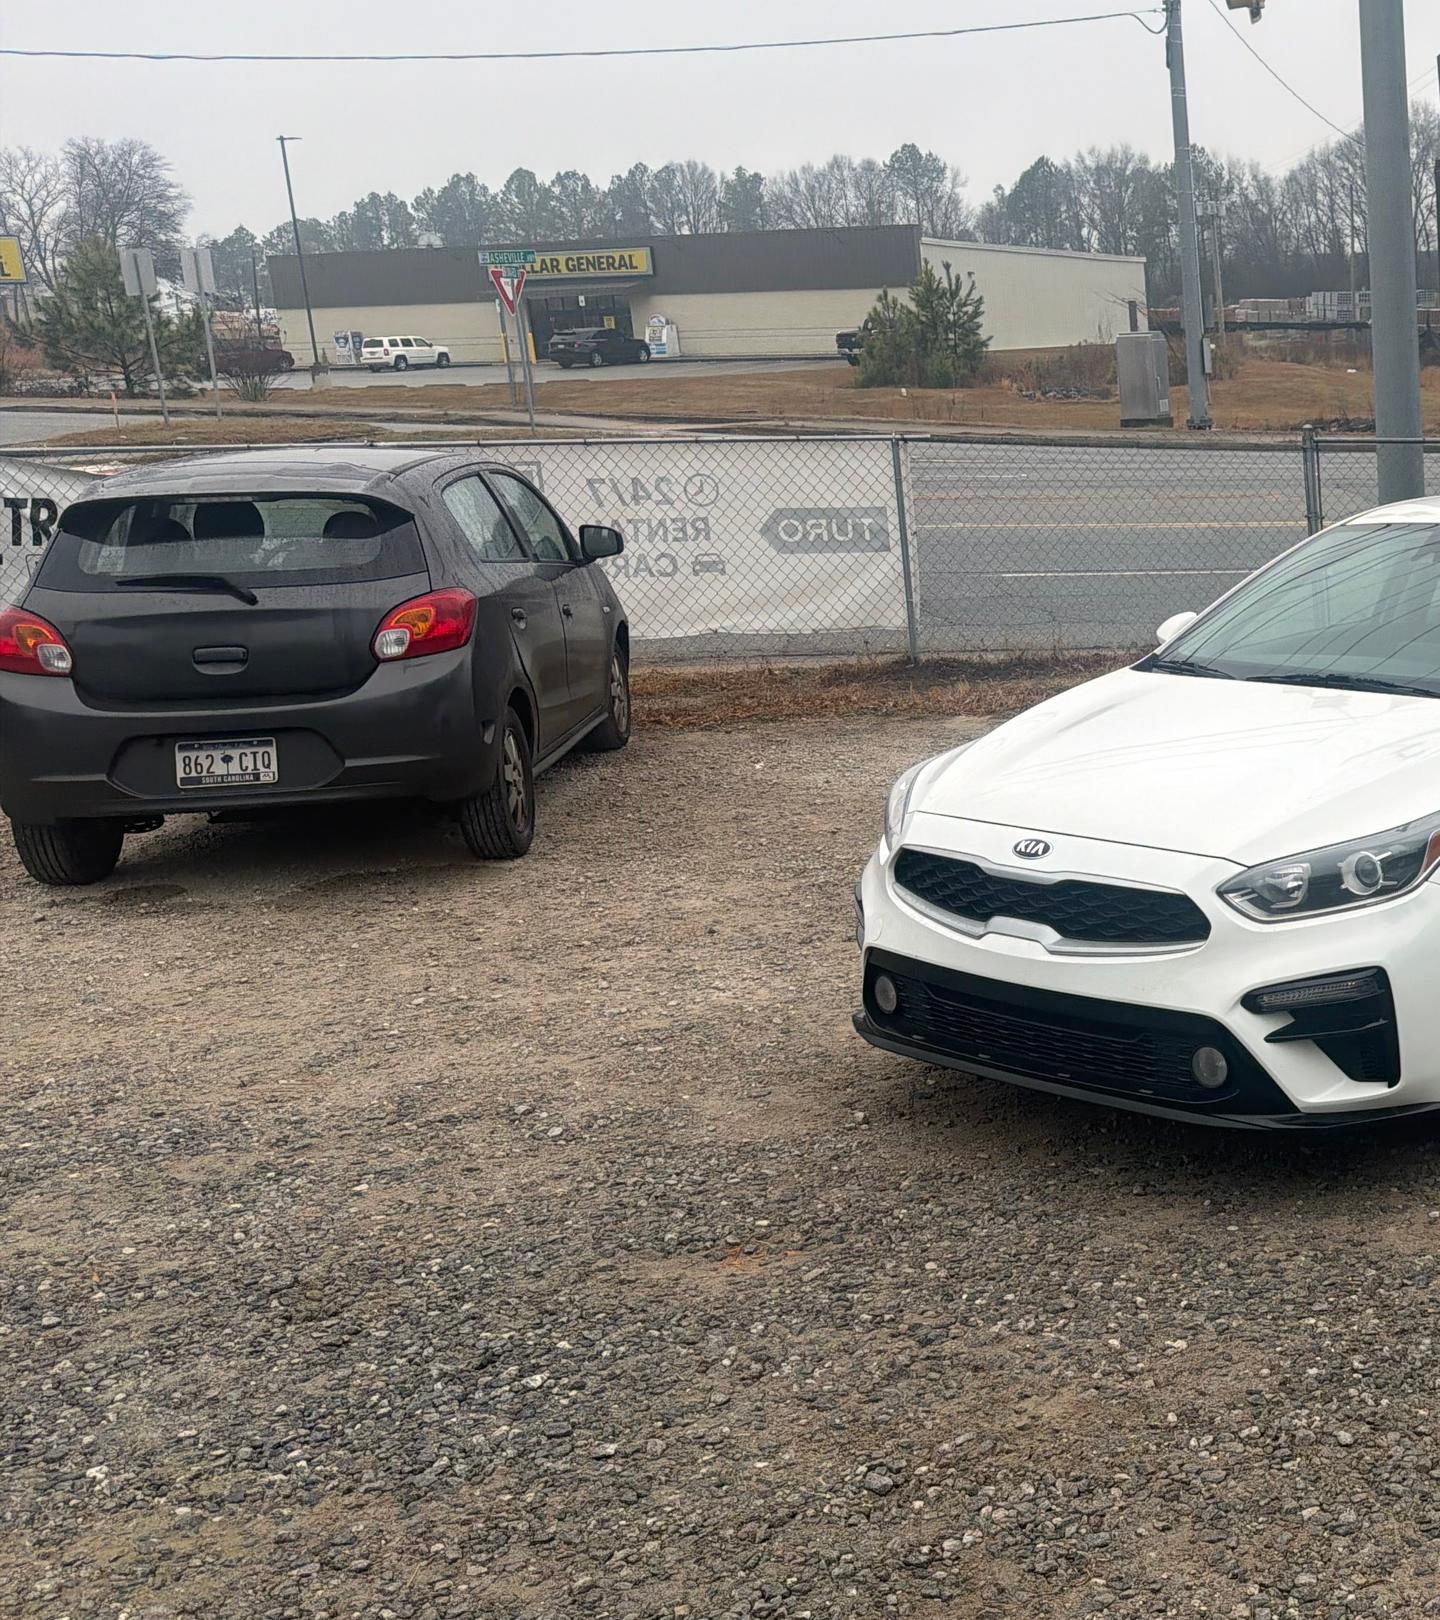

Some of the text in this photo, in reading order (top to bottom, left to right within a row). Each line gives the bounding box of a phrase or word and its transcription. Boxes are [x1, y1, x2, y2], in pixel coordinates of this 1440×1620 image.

[489, 251, 525, 263] ASHEVILLE
[565, 254, 639, 272] GENERAL
[182, 750, 272, 776] 862 CIQ
[201, 773, 254, 785] SOUTH CAROLINA
[1016, 840, 1046, 856] KIA
